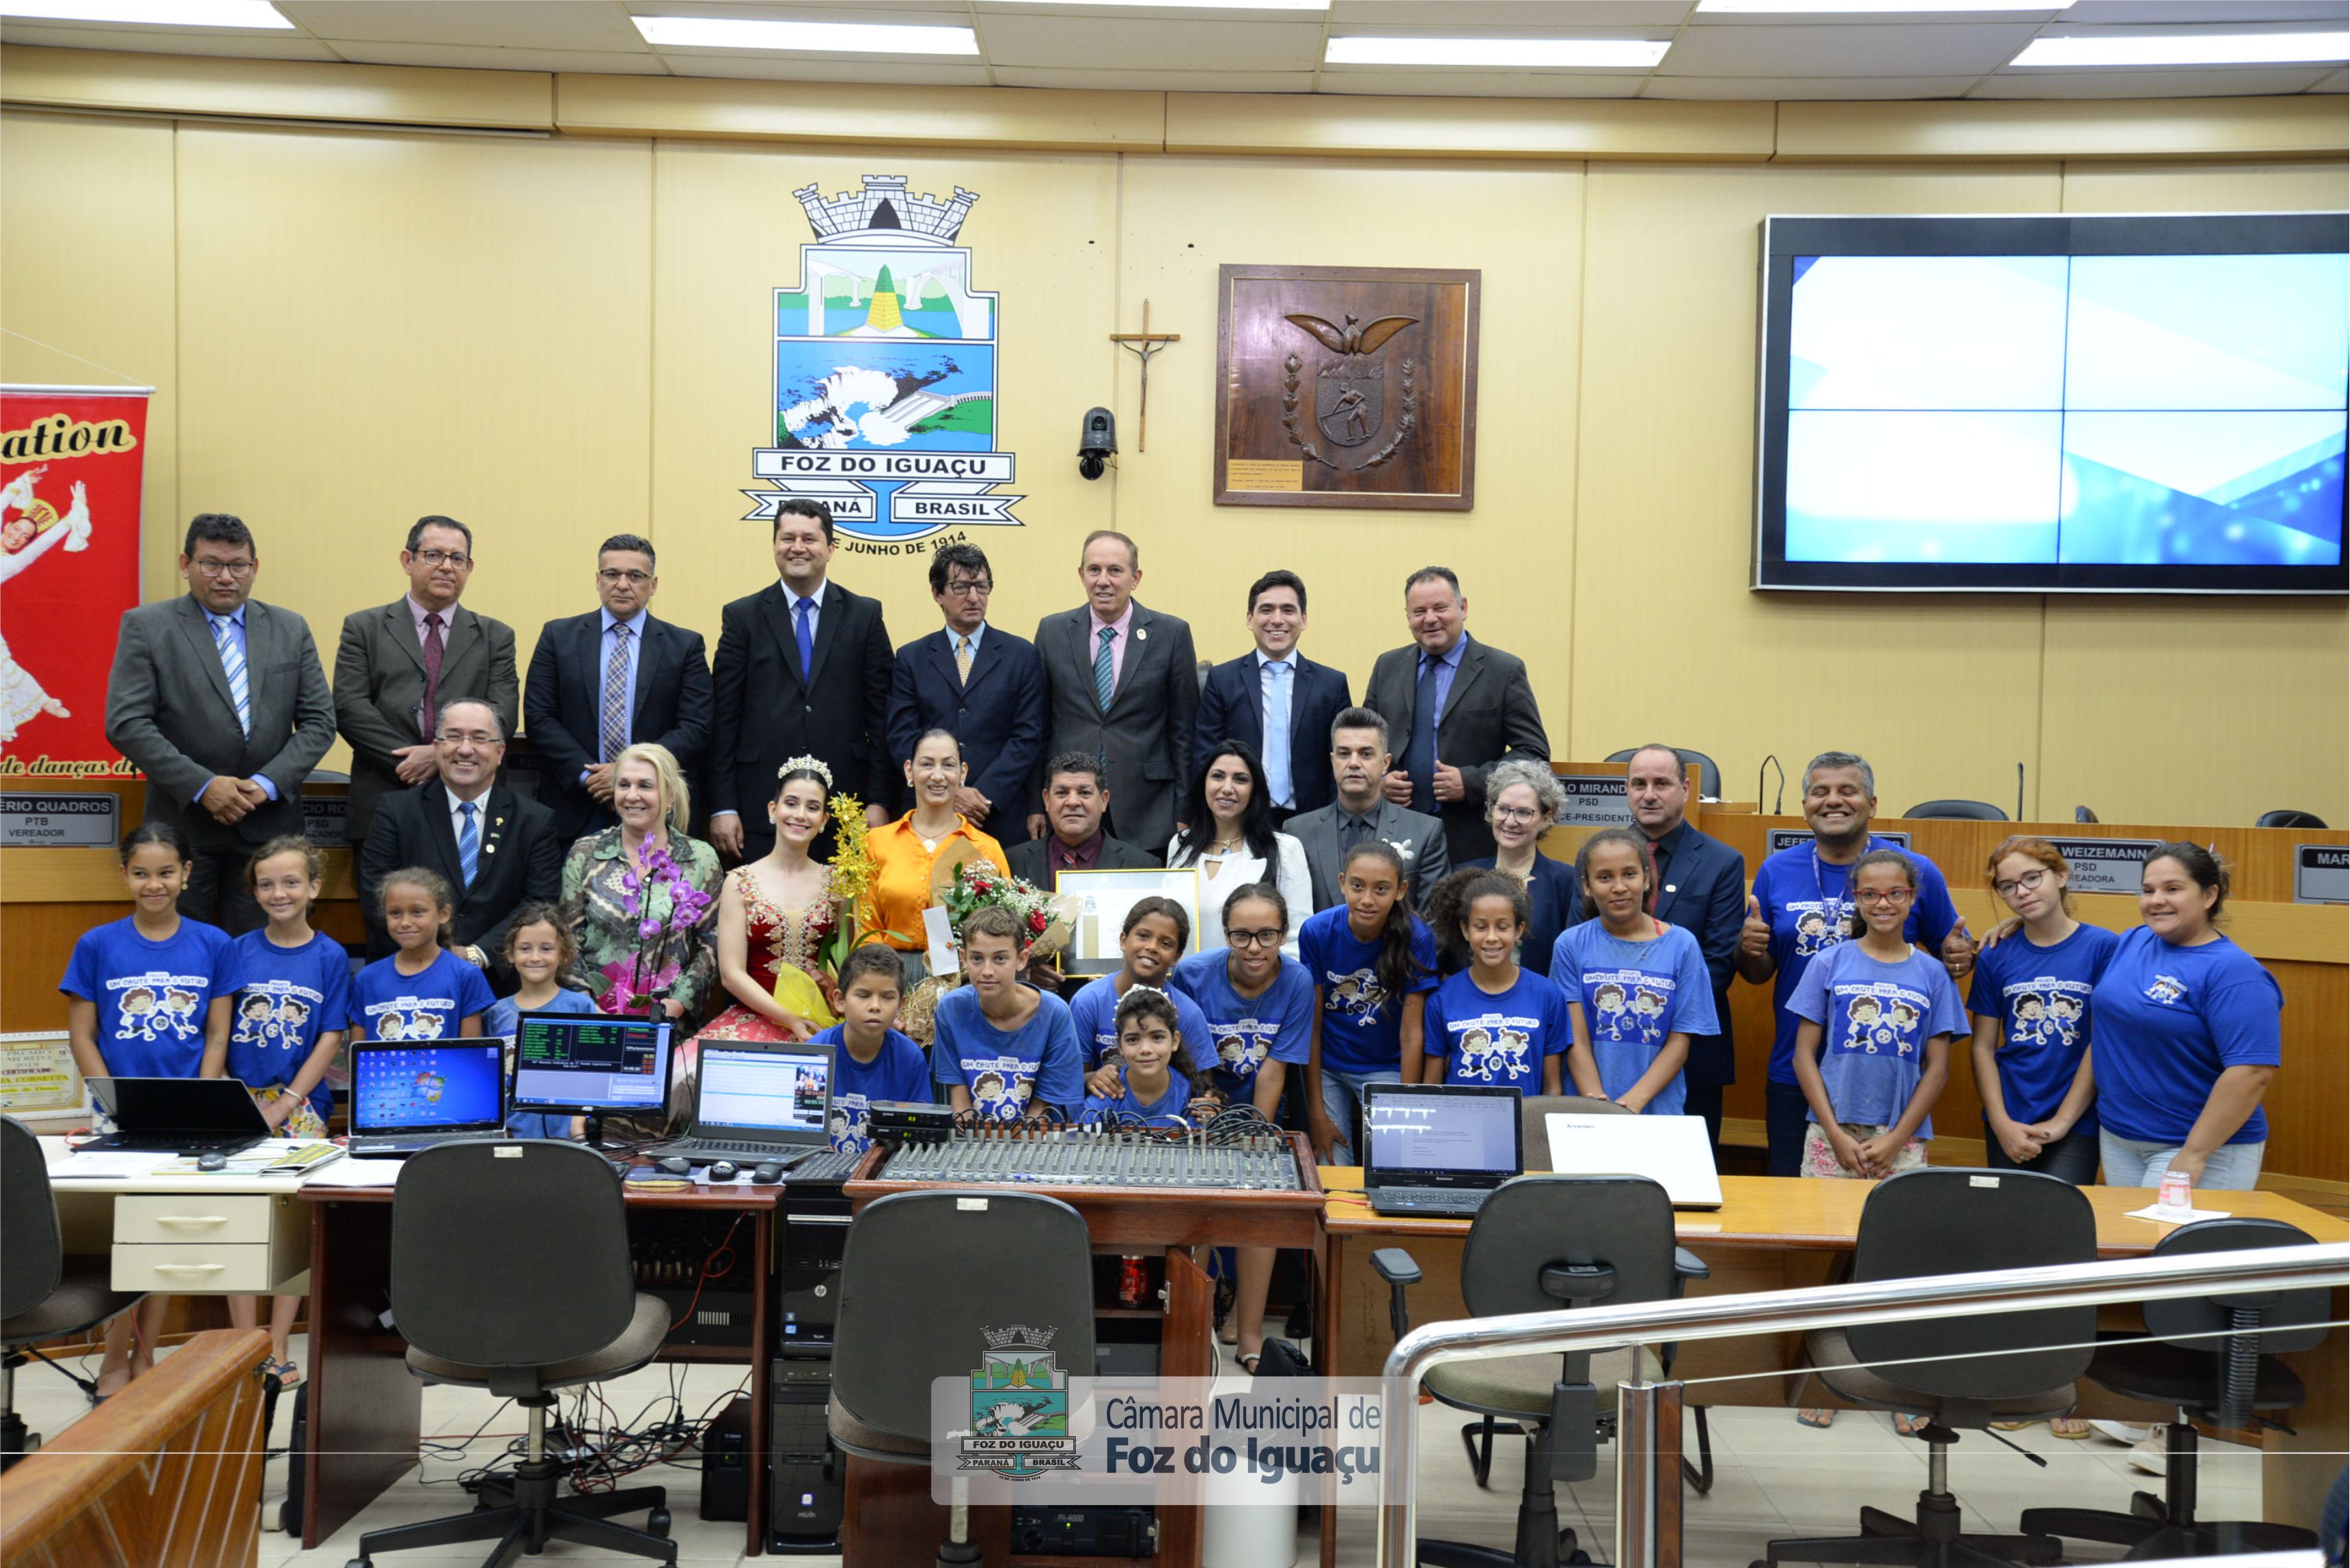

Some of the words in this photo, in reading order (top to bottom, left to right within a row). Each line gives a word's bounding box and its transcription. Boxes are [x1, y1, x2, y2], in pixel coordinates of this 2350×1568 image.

[782, 456, 831, 471] FOZ
[841, 457, 876, 472] DO
[887, 458, 986, 478] IGUAÇU
[915, 503, 990, 516] BRASIL
[845, 542, 900, 555] JUNHO
[906, 542, 926, 555] DE
[931, 532, 966, 550] 1914
[29, 757, 109, 778] danças
[36, 802, 109, 812] QUADROS
[1579, 798, 1599, 806] PSD
[25, 817, 49, 826] PTB
[2062, 847, 2147, 859] WEIZEMANN
[2075, 863, 2097, 871] PSD
